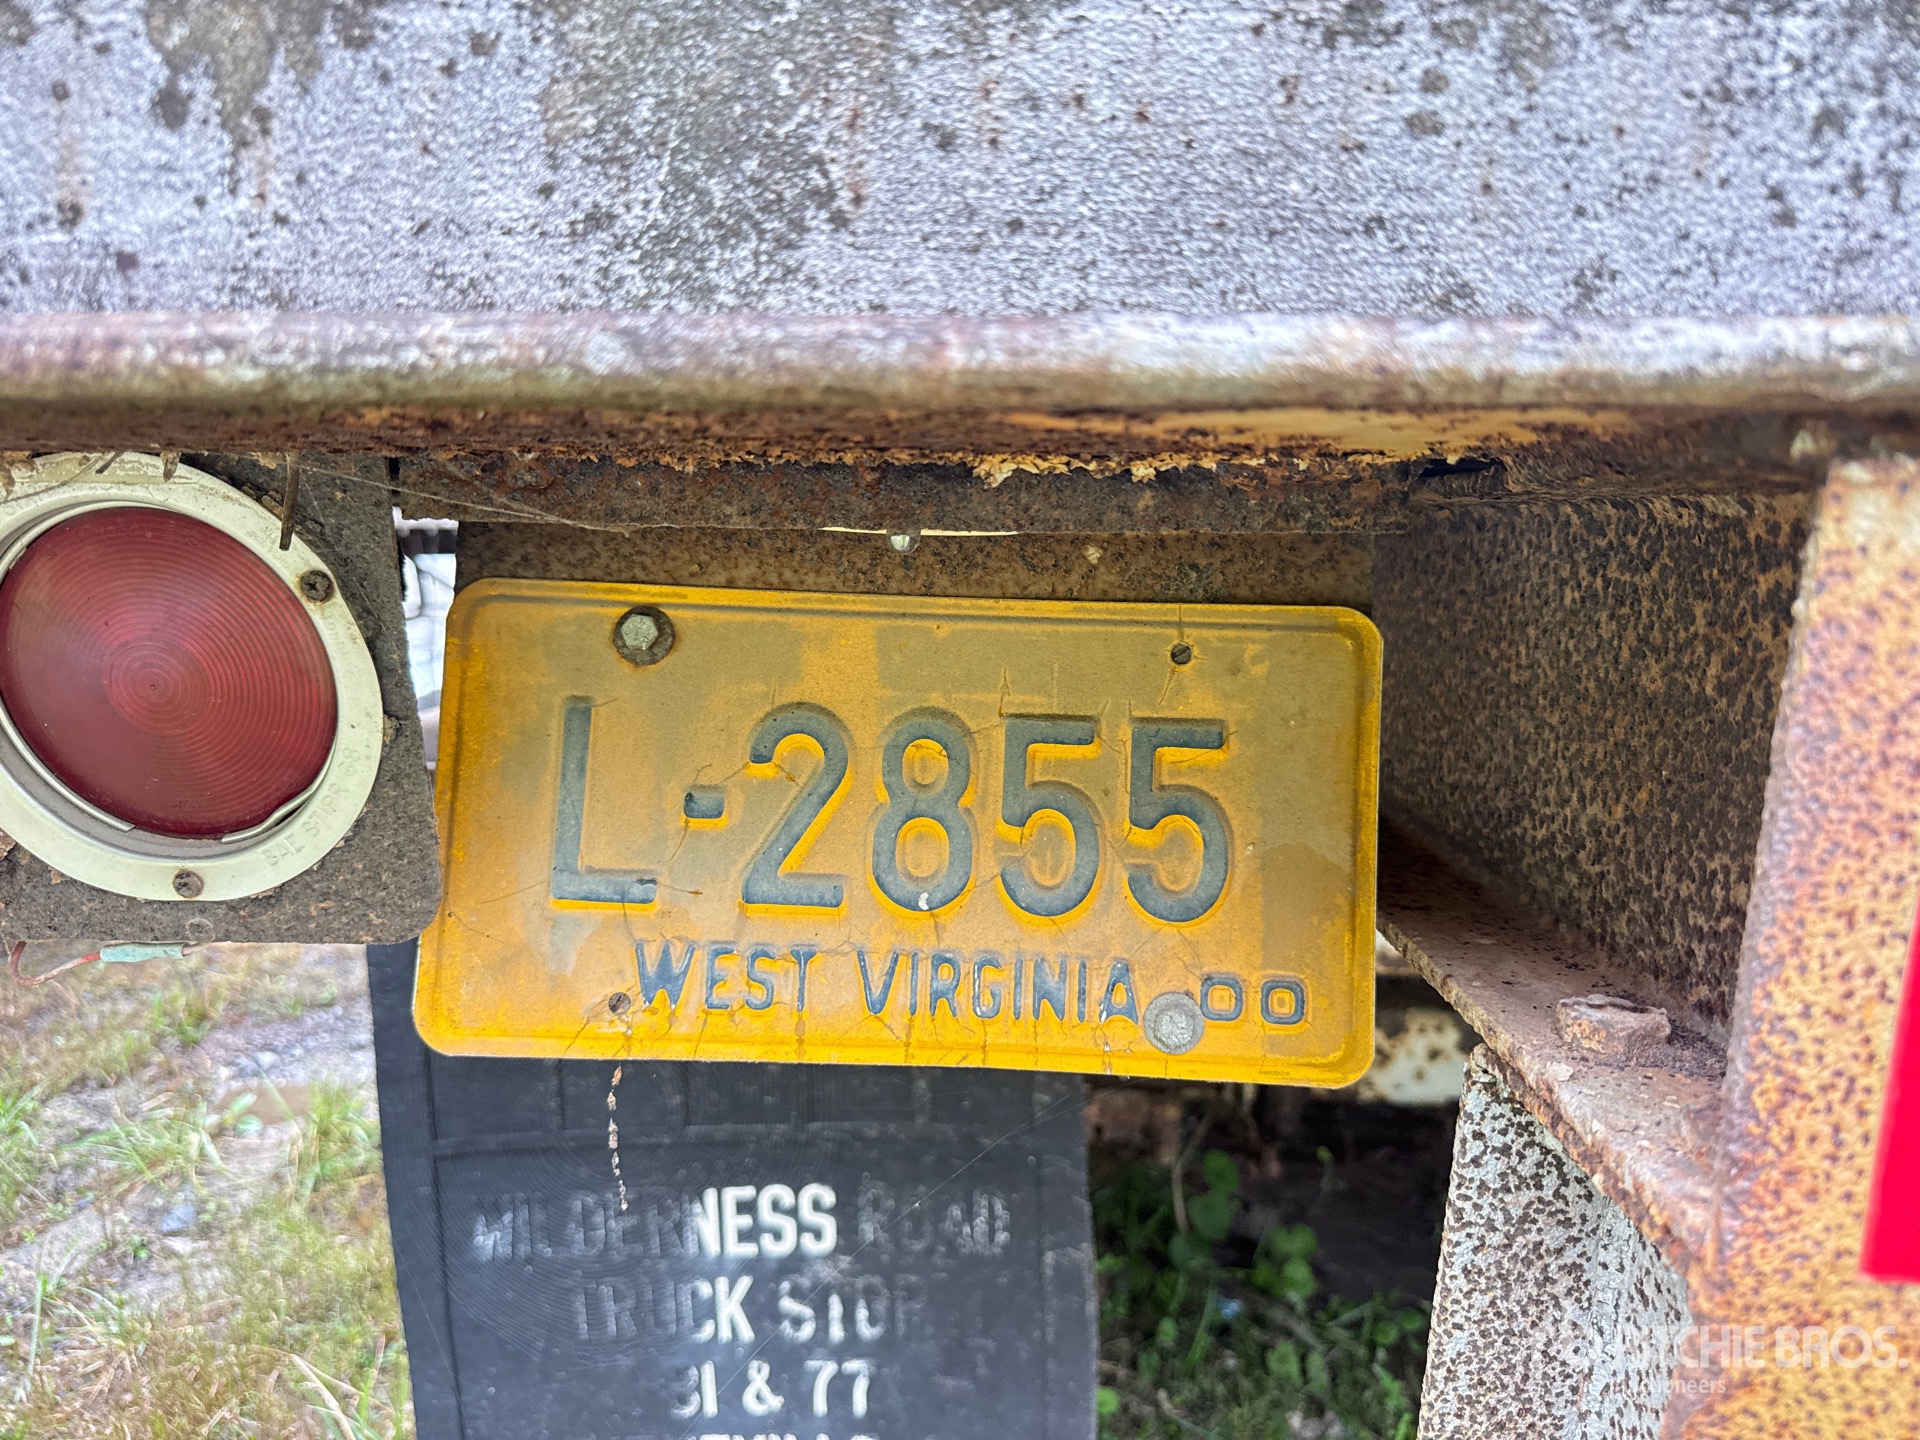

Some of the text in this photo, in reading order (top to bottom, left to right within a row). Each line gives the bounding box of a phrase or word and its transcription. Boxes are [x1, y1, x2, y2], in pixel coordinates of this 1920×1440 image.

[551, 694, 1232, 924] L-2855
[634, 940, 818, 1013] WEST
[856, 948, 1139, 1026] VIRGINIA
[742, 1359, 785, 1416] &
[804, 1358, 876, 1418] 77
